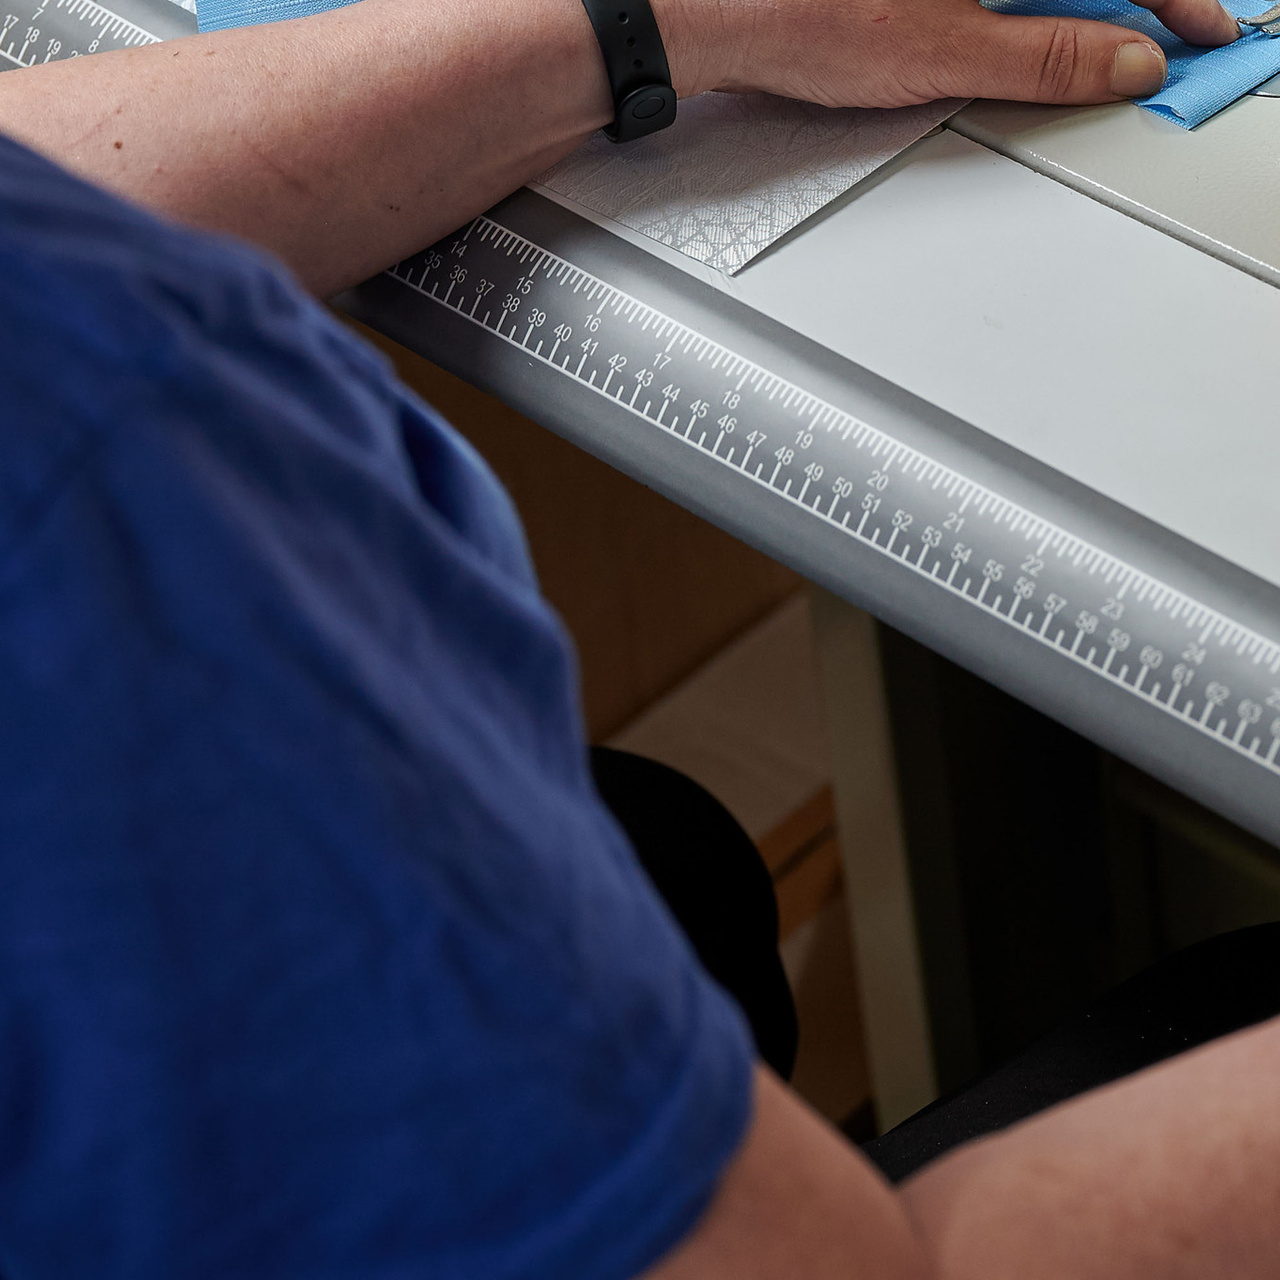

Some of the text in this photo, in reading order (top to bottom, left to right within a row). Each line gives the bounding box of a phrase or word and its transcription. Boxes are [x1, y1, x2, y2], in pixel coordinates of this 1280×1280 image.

[4, 14, 19, 29] 17
[25, 27, 39, 42] 18
[47, 39, 61, 55] 19
[32, 7, 99, 53] 7 8
[425, 251, 443, 269] 35
[450, 265, 467, 283] 36
[476, 279, 495, 296] 37
[502, 294, 520, 312] 38
[528, 308, 546, 327] 39
[554, 323, 572, 342] 40
[581, 338, 599, 356] 41
[608, 354, 627, 373] 42
[635, 369, 654, 387] 43
[662, 384, 681, 402] 44
[690, 399, 710, 418] 45
[717, 414, 737, 434] 46
[746, 429, 767, 449] 47
[774, 446, 794, 466] 48
[804, 462, 824, 482] 49
[832, 477, 852, 498] 50
[861, 493, 881, 514] 51
[891, 509, 913, 531] 52
[921, 526, 942, 548] 53
[951, 543, 972, 564] 54
[983, 559, 1005, 582] 55
[1013, 577, 1036, 599] 56
[1043, 593, 1067, 614] 57
[1075, 610, 1099, 634] 58
[1107, 628, 1131, 652] 59
[1139, 645, 1163, 669] 60
[1171, 663, 1194, 687] 61
[451, 241, 467, 258] 14
[515, 276, 534, 295] 15
[584, 314, 601, 332] 16
[653, 353, 672, 370] 17
[722, 391, 740, 409] 18
[794, 430, 813, 450] 19
[866, 471, 888, 491] 20
[943, 512, 965, 533] 21
[1020, 554, 1044, 577] 22
[1101, 597, 1125, 620] 23
[1182, 642, 1207, 665] 24
